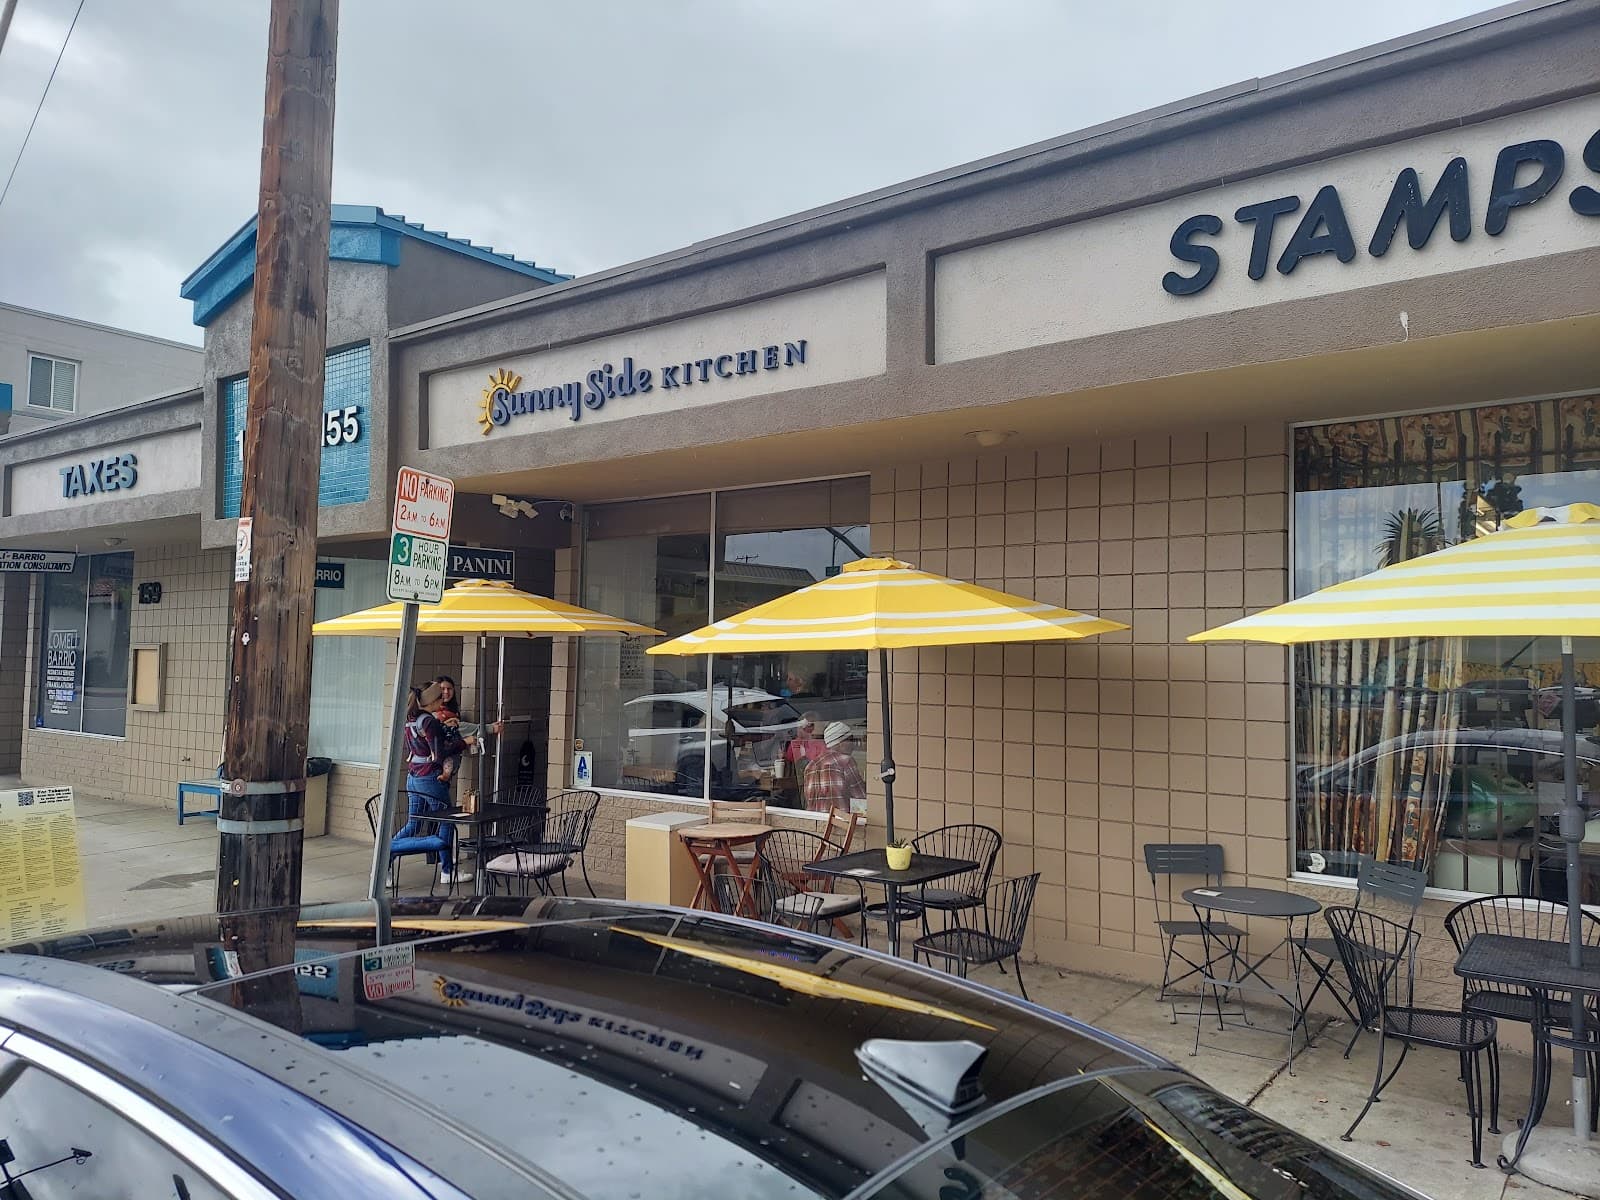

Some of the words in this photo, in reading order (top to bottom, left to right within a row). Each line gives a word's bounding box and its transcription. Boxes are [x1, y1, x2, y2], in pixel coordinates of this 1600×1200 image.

[660, 339, 807, 389] KITCHEN
[59, 453, 138, 498] TAXES
[401, 472, 418, 499] NO
[420, 481, 449, 504] PARKING
[12, 552, 46, 561] BARRIO
[397, 536, 410, 563] 3
[418, 542, 440, 555] HOUR
[23, 562, 72, 571] CONSULTANTS
[412, 552, 442, 572] PARKING
[452, 555, 512, 575] PANINI
[48, 632, 78, 650] LOMELI
[47, 650, 76, 666] BARRIO
